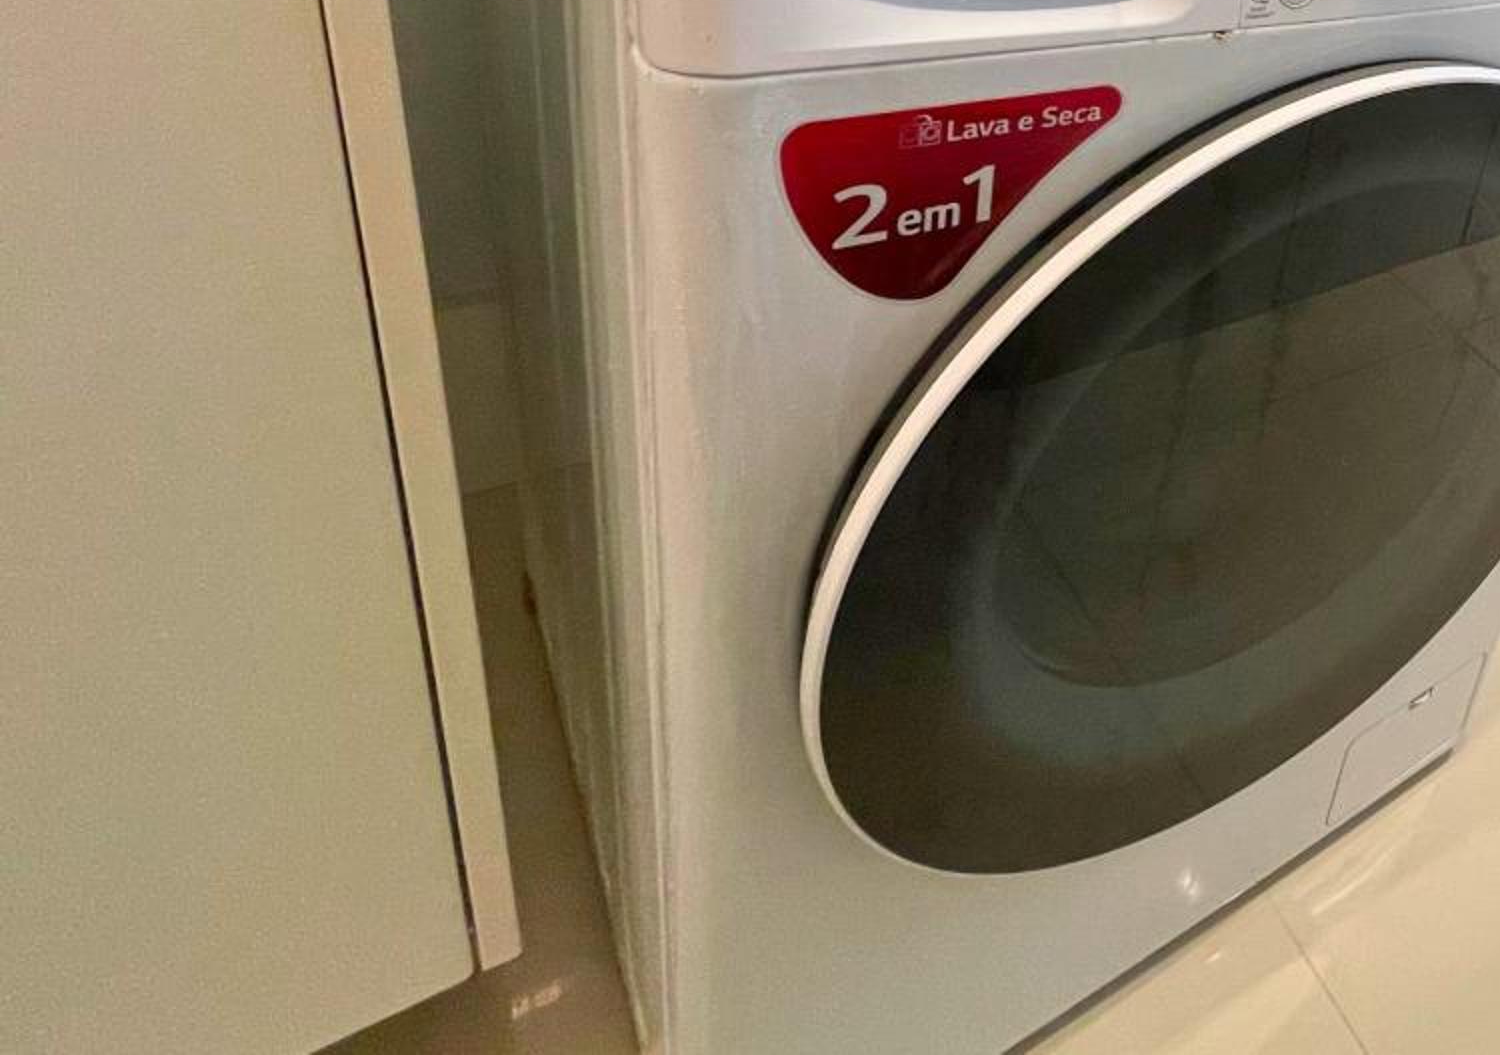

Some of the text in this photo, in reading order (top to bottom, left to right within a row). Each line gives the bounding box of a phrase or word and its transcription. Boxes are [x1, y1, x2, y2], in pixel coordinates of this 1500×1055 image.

[946, 104, 1101, 143] Lava e Seca
[831, 163, 996, 250] 2 em 1
